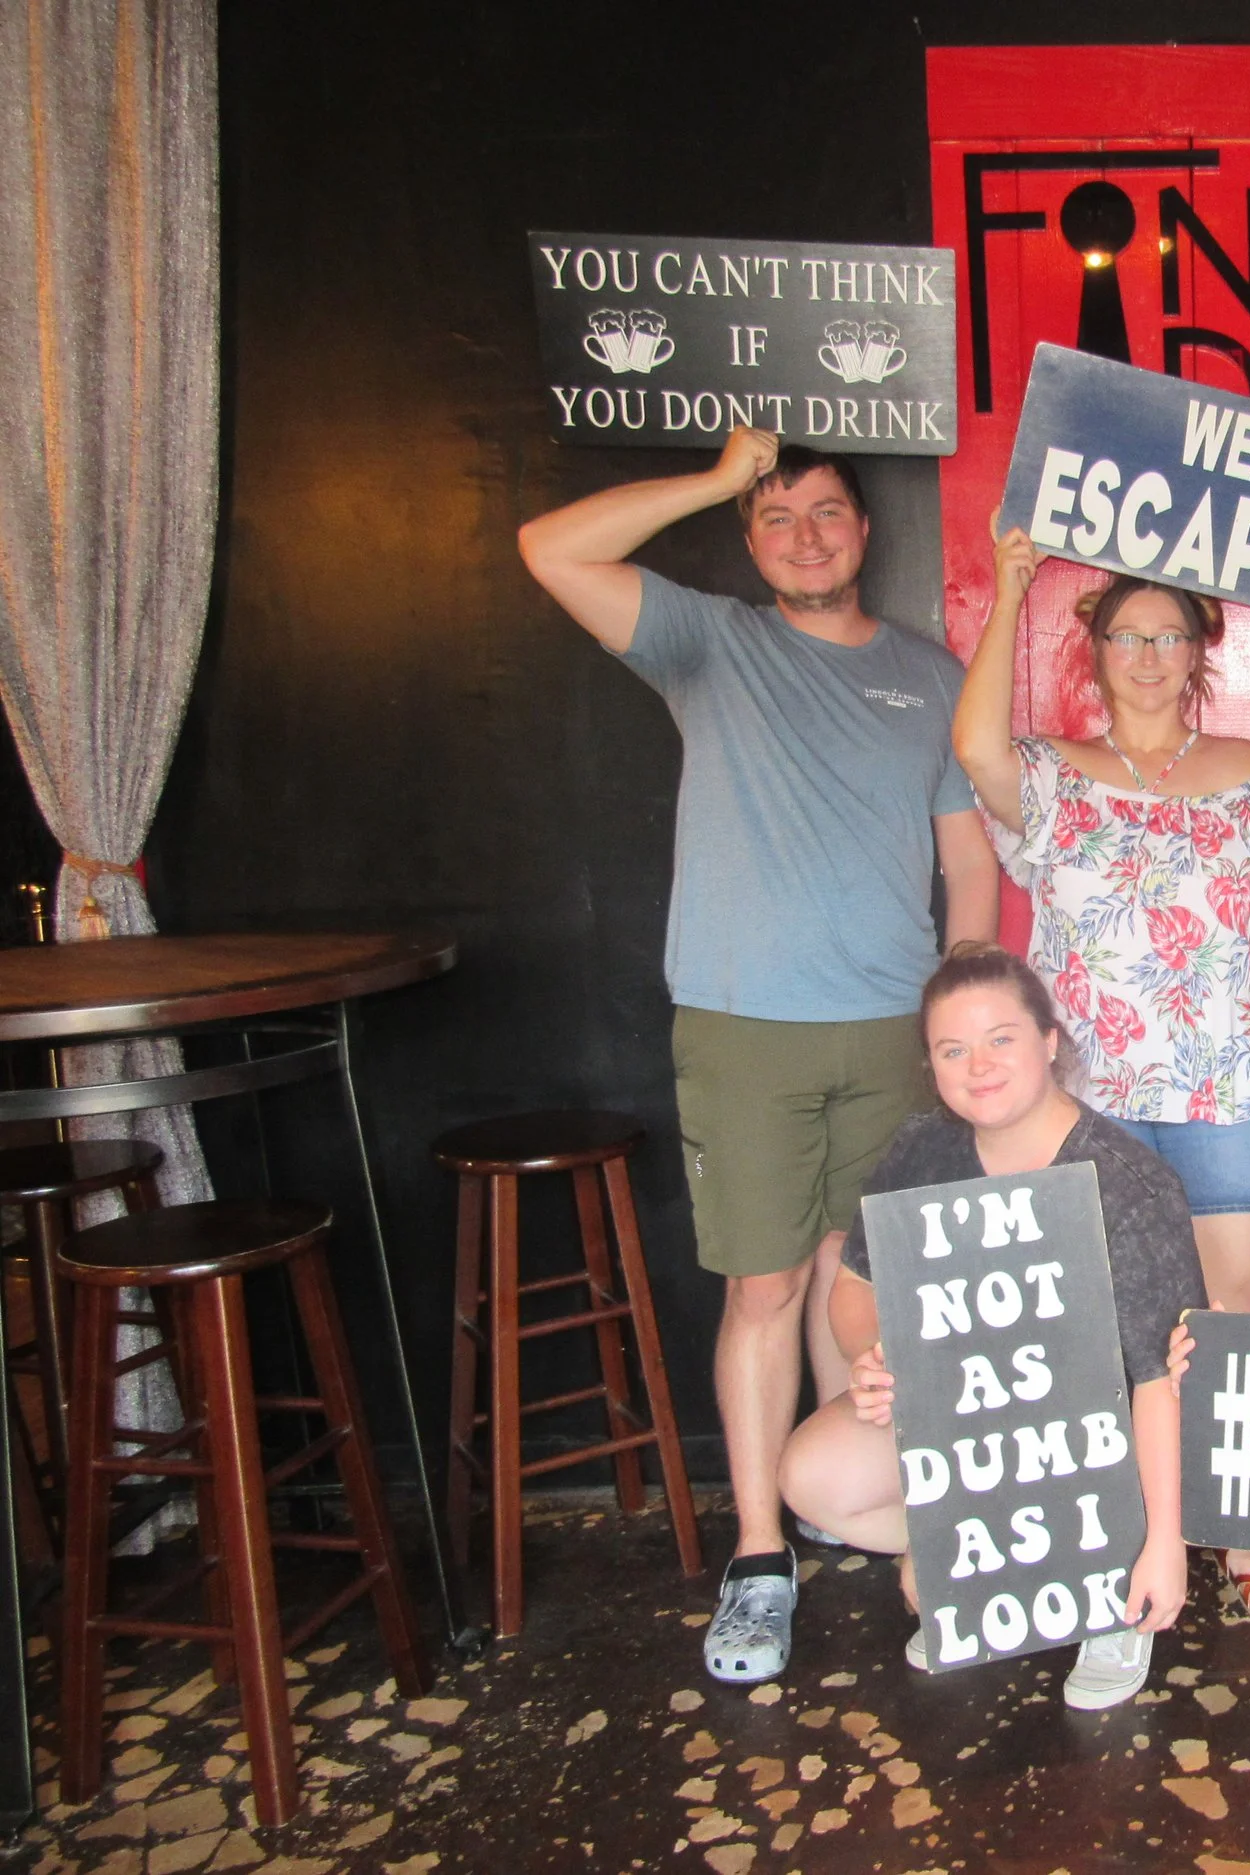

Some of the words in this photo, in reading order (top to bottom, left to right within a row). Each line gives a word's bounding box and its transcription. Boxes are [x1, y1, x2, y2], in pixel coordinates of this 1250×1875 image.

[540, 247, 640, 294] YOU
[655, 252, 790, 300] CAN'T
[802, 259, 945, 307] THINK
[728, 325, 769, 367] IF
[551, 386, 648, 430] YOU
[661, 391, 792, 436] DON'T
[804, 397, 947, 442] DRINK
[919, 1187, 1044, 1259] I'M
[915, 1260, 1065, 1341] NOT
[955, 1343, 1053, 1415] AS
[900, 1411, 1129, 1506] DUMB
[950, 1504, 1052, 1579] AS
[1075, 1493, 1109, 1551] I
[933, 1567, 1143, 1665] LOOK
